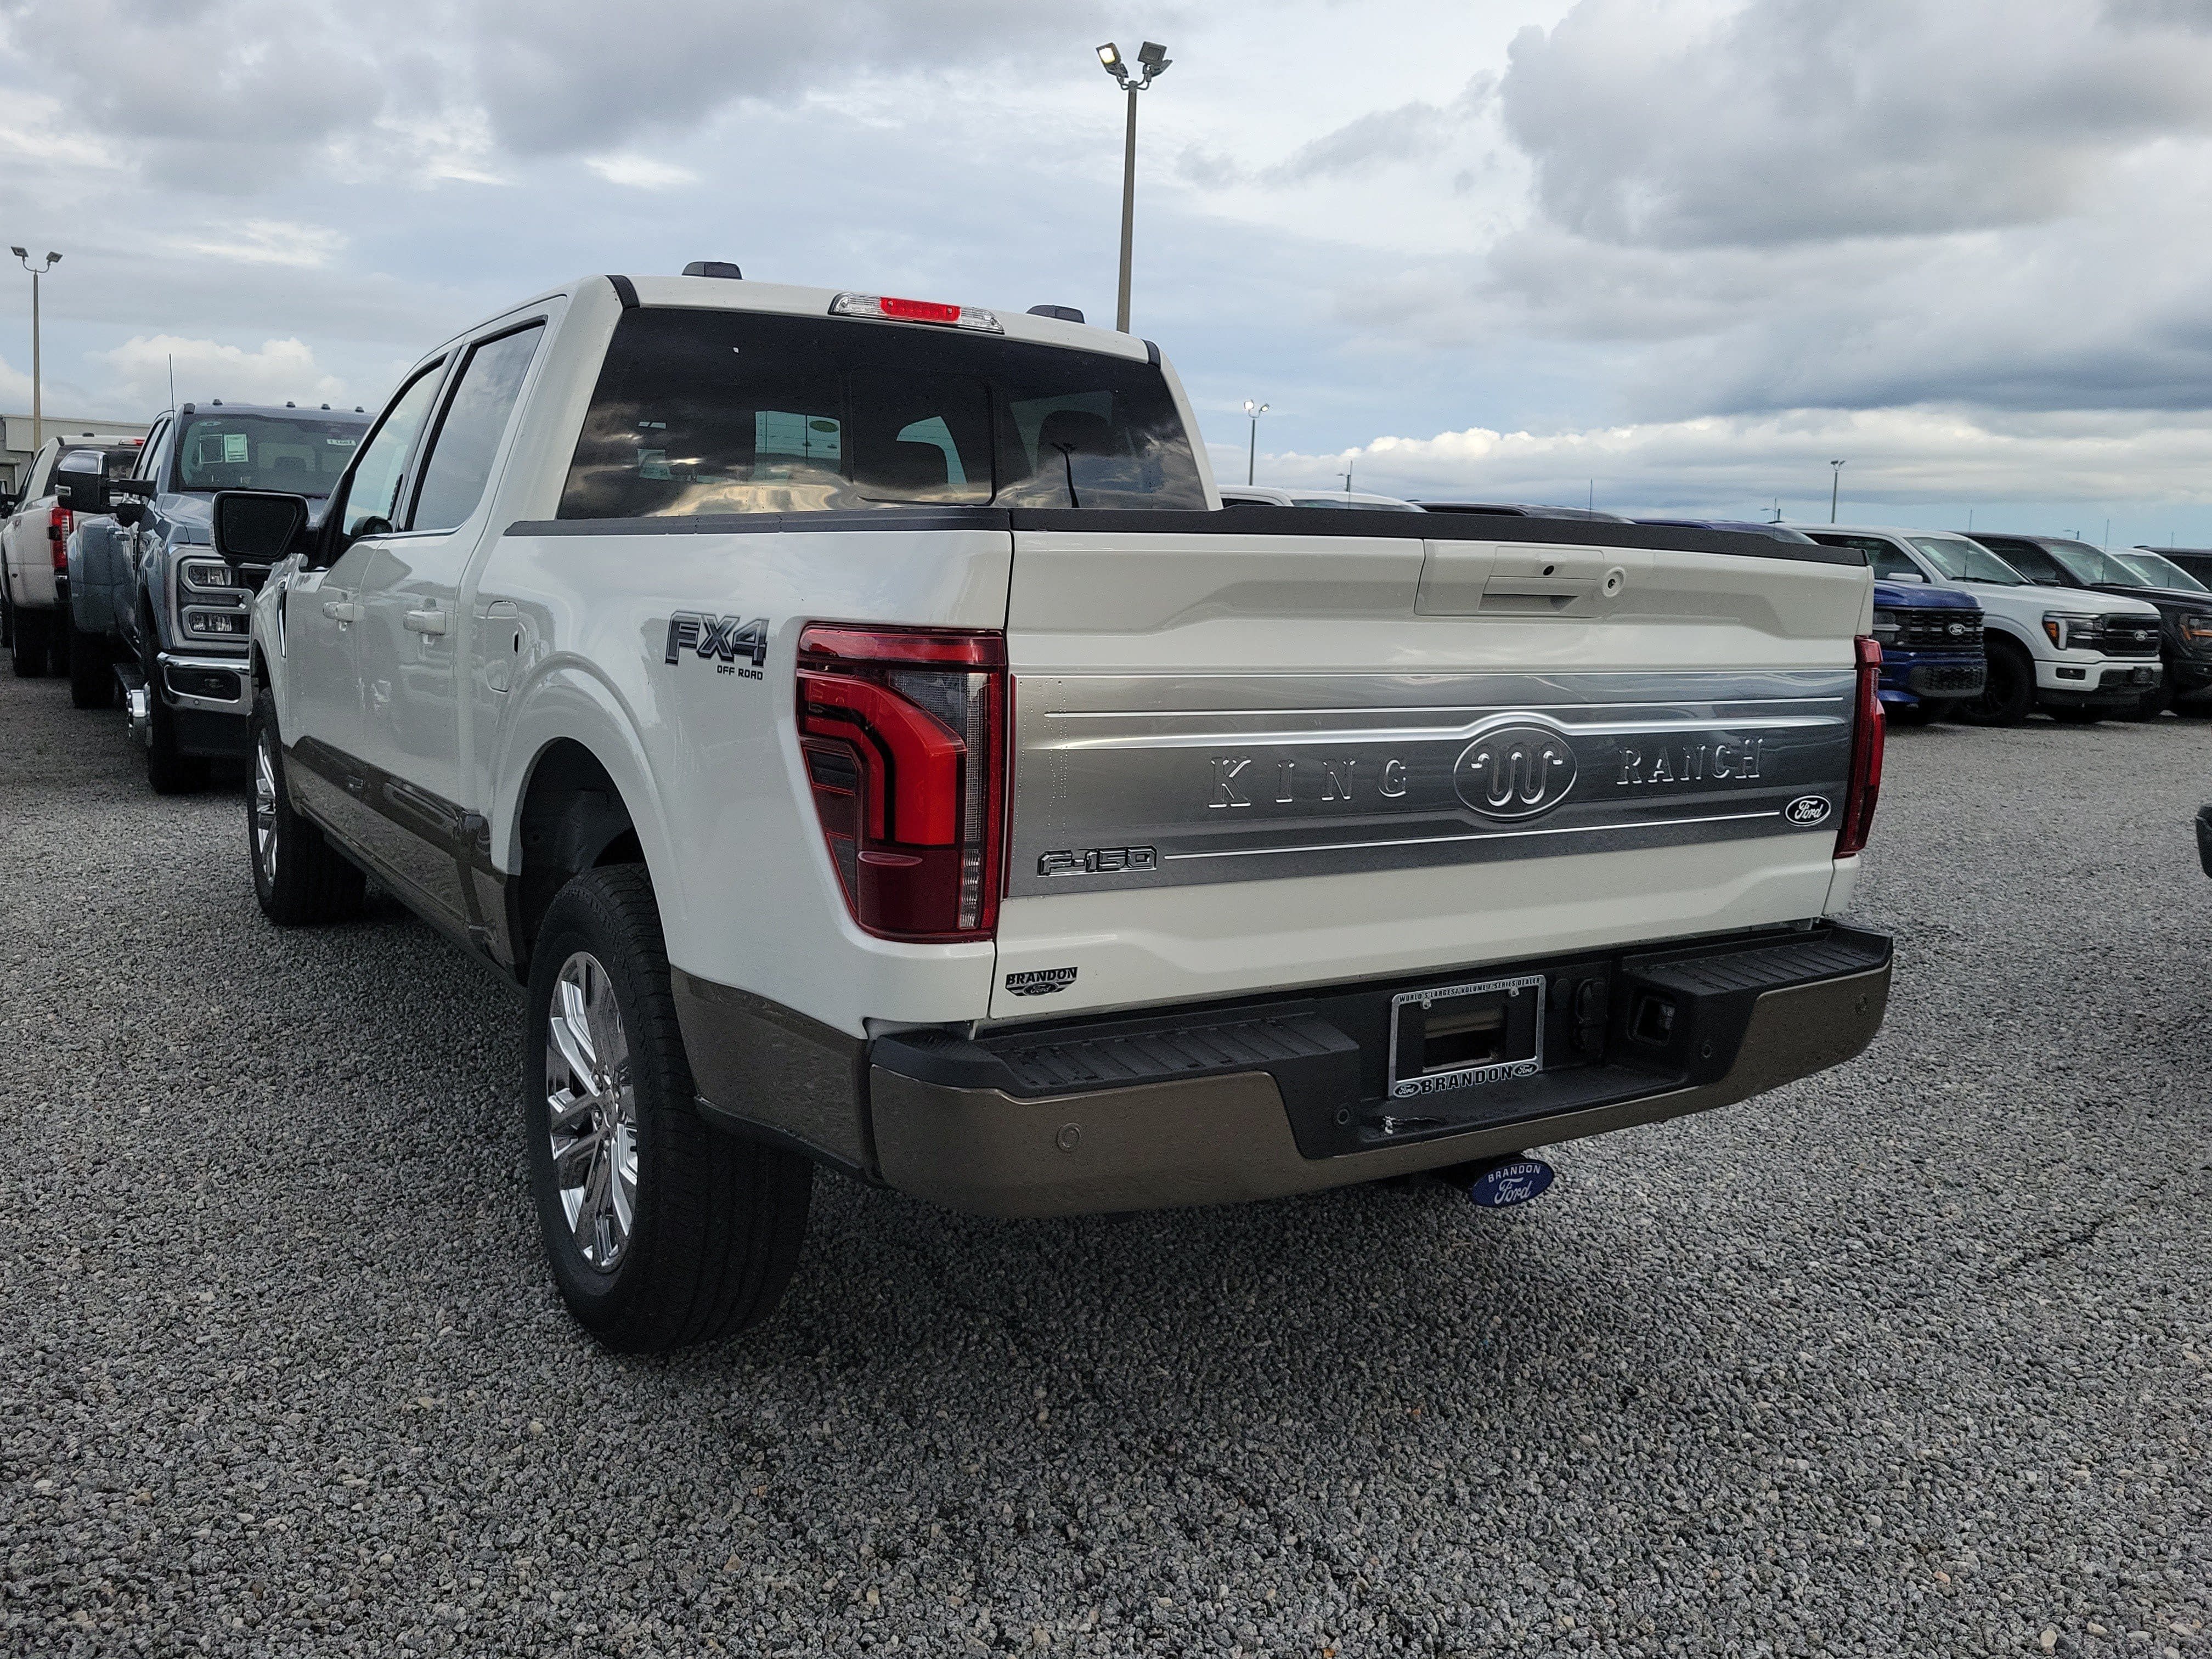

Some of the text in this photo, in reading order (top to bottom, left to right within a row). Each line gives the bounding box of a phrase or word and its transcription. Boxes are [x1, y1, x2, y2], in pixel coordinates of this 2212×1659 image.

[665, 611, 769, 668] FX4
[716, 664, 763, 680] OFF ROAD
[1208, 756, 1407, 808] KING
[1616, 738, 1763, 785] RANCH
[1794, 800, 1824, 820] Ford
[1037, 845, 1158, 878] F-150
[1006, 967, 1077, 985] BRANDON
[1430, 988, 1459, 998] LARGEST
[1461, 984, 1486, 994] VOLUME
[1517, 977, 1540, 986] DEALER
[1398, 1064, 1534, 1095] Ford BRANDON Ford
[1488, 1164, 1542, 1183] BRANDON
[1494, 1176, 1533, 1205] Ford
